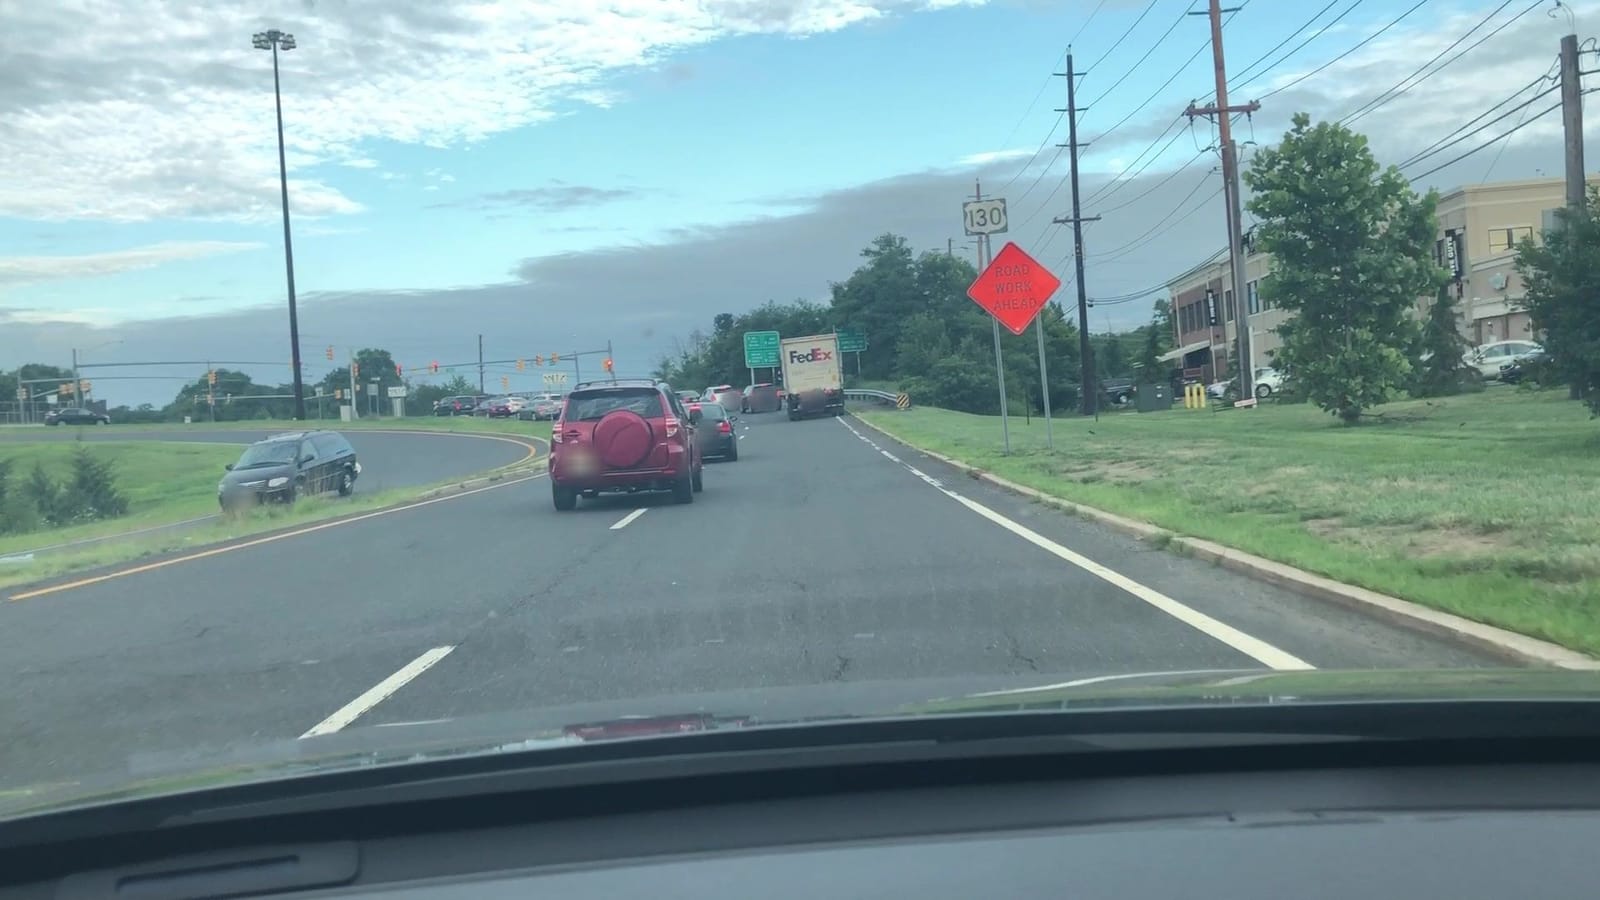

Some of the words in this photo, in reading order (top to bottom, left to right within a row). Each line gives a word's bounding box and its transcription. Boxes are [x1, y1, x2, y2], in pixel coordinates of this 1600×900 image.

[968, 207, 1002, 228] 130
[995, 264, 1030, 278] ROAD
[995, 280, 1032, 294] WORK
[993, 297, 1037, 311] AHEAD
[790, 347, 832, 364] FedEx
